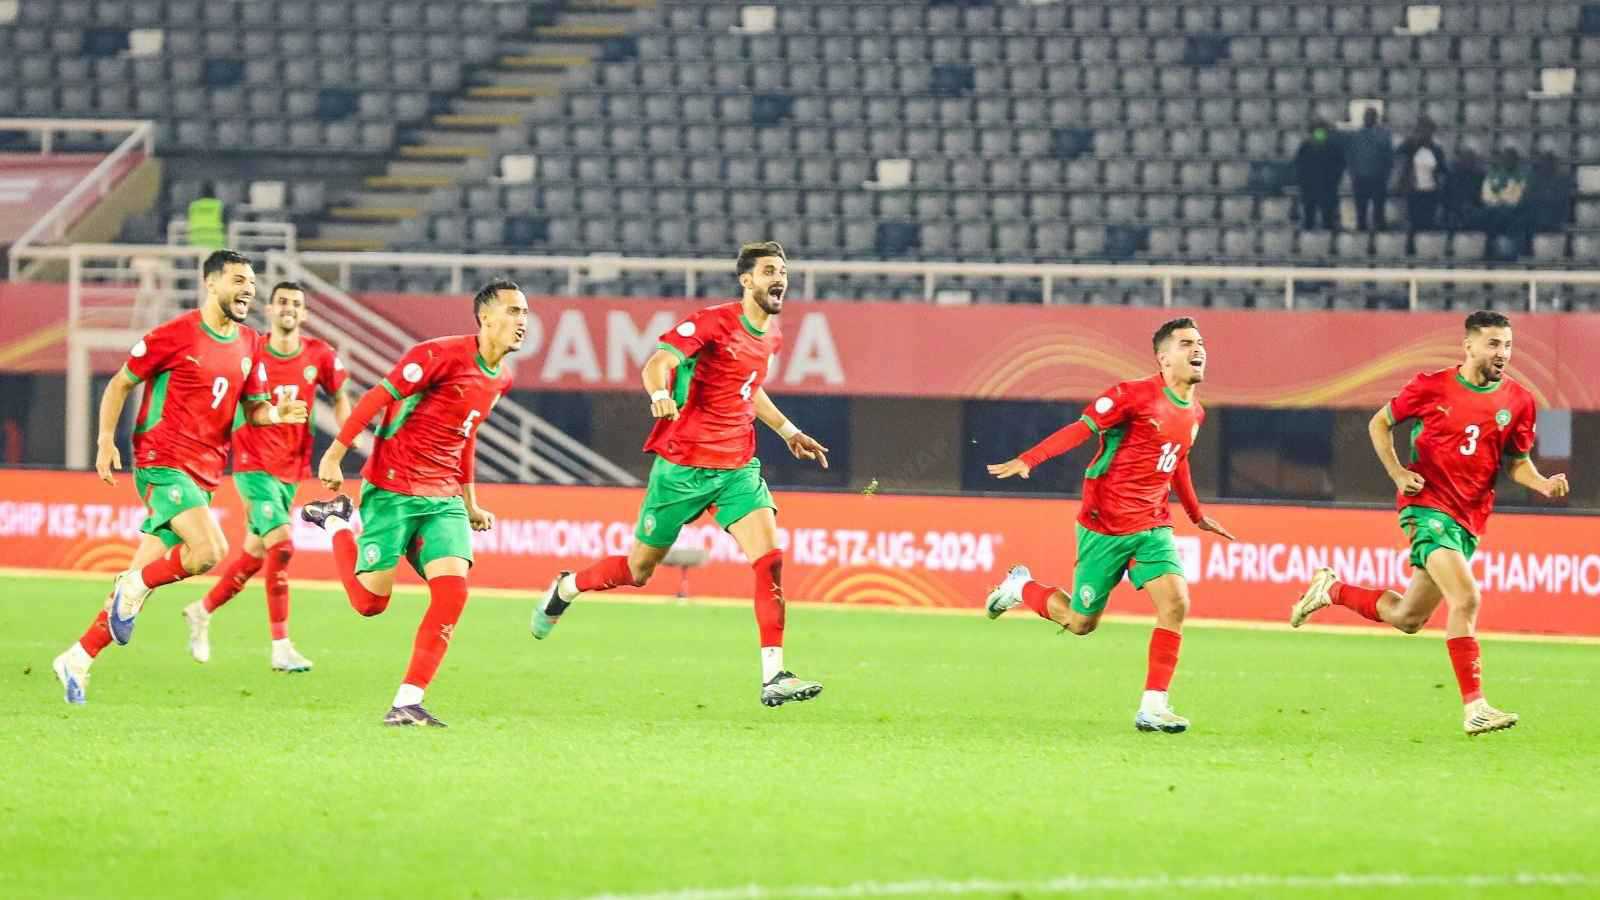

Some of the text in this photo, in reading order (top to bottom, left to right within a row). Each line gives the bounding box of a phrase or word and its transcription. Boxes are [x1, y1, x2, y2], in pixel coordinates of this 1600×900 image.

[211, 376, 229, 409] 9
[273, 384, 299, 405] 17
[1459, 424, 1480, 456] 3
[1156, 442, 1181, 473] 16
[500, 519, 602, 558] NATIONS
[1207, 543, 1327, 583] AFRICAN
